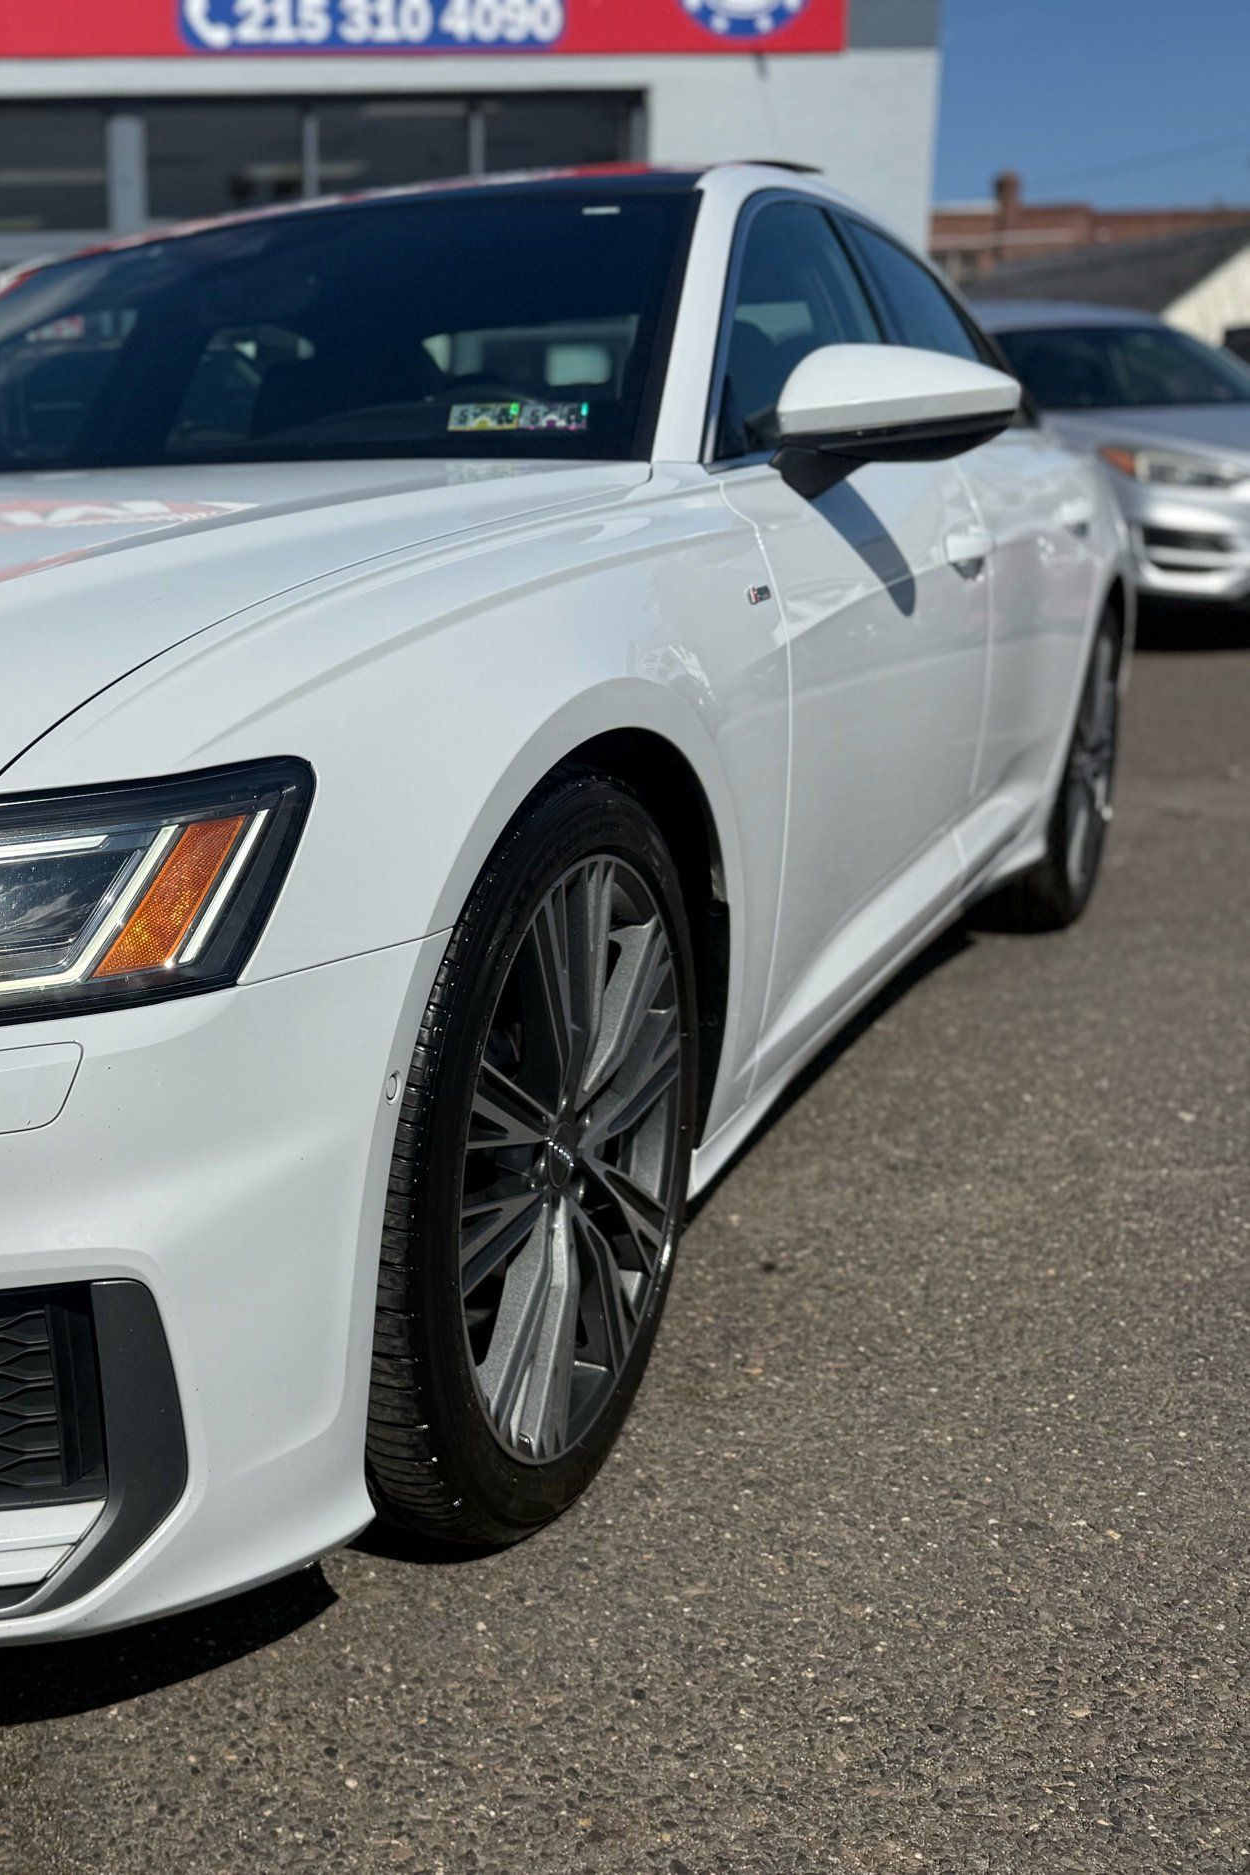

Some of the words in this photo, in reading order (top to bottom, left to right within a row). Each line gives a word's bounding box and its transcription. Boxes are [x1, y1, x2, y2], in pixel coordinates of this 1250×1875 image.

[233, 0, 332, 44] 215
[338, 0, 433, 44] 310
[439, 0, 565, 43] 4090
